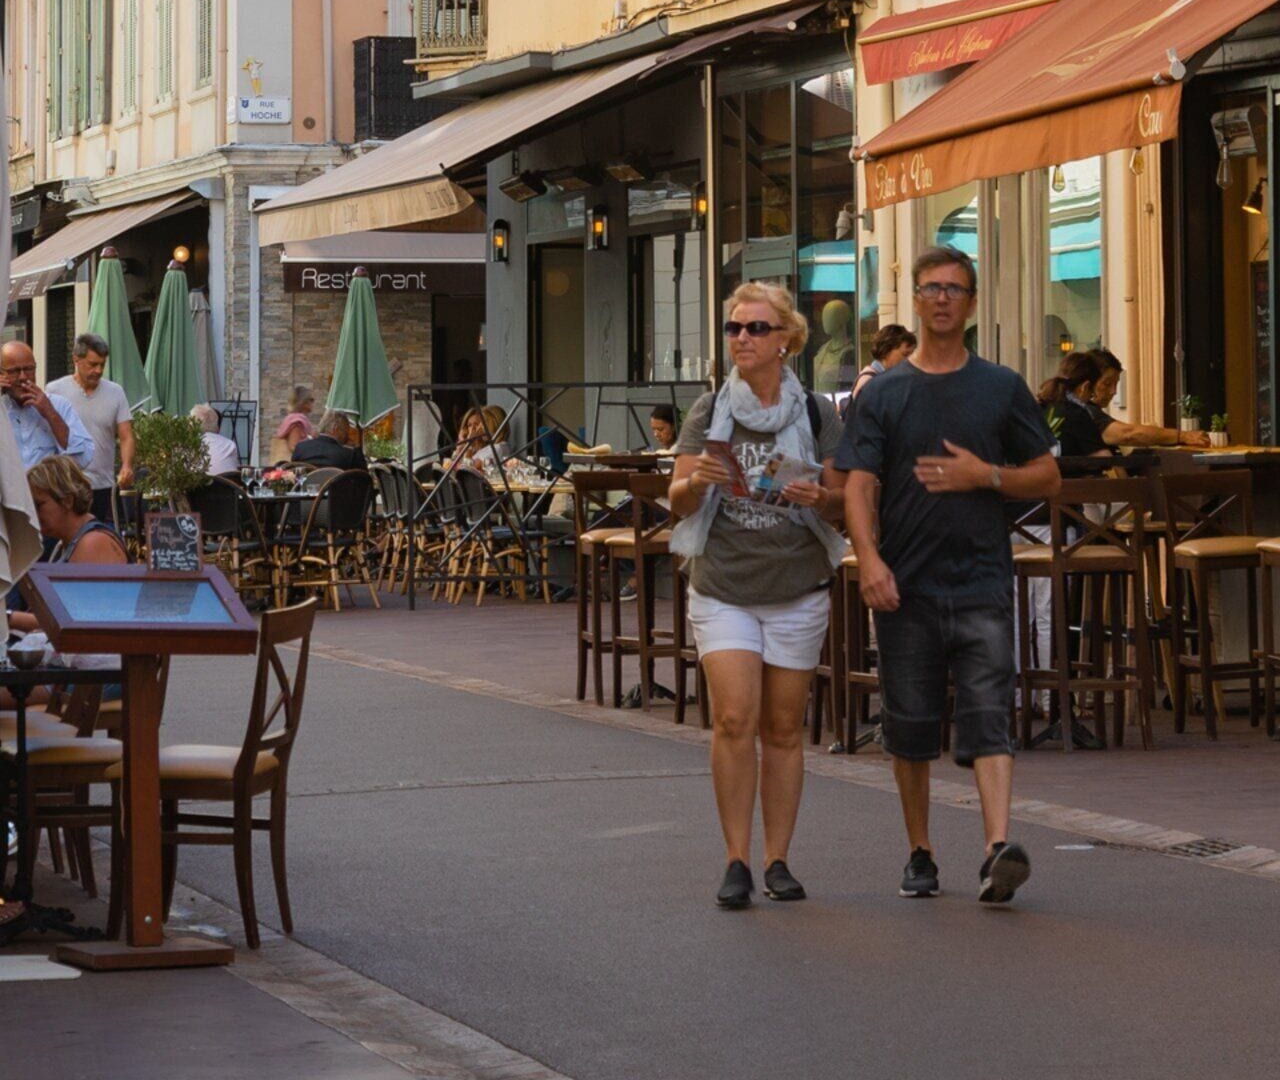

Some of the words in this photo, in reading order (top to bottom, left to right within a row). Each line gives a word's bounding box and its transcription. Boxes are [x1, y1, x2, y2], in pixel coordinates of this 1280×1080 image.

[259, 100, 275, 109] RUE
[250, 111, 283, 120] HOCHE
[301, 268, 427, 290] Resturant
